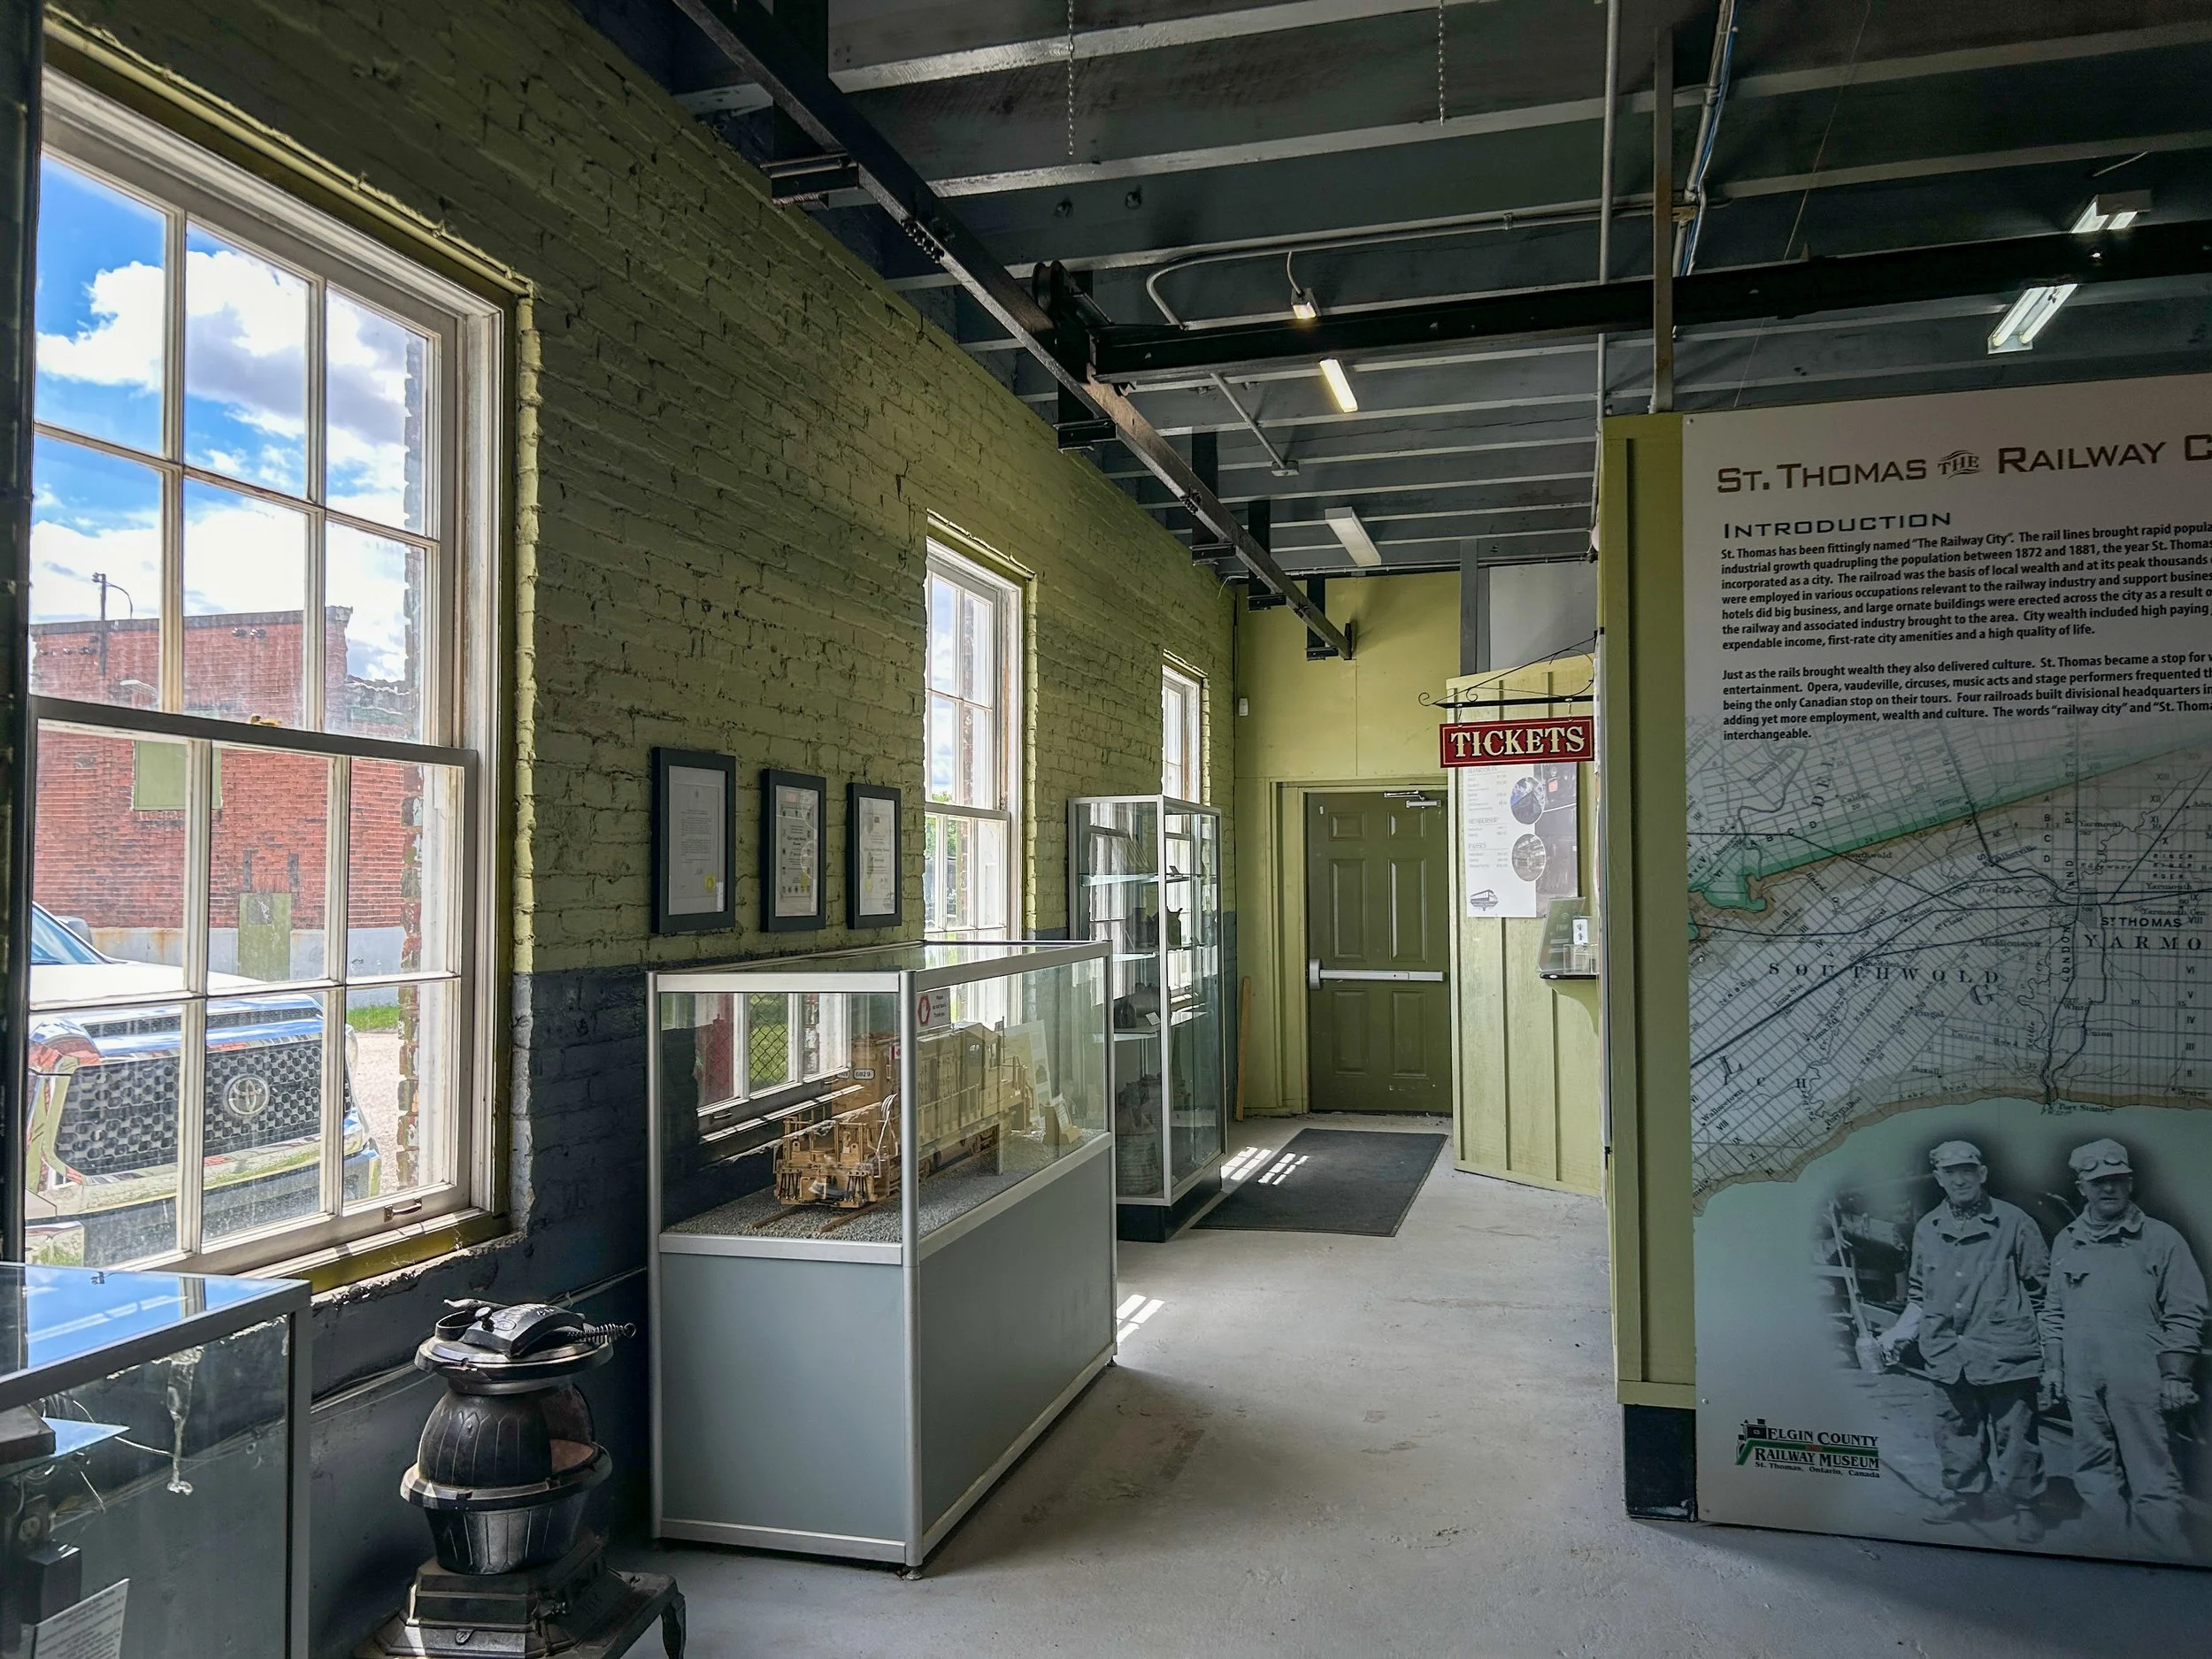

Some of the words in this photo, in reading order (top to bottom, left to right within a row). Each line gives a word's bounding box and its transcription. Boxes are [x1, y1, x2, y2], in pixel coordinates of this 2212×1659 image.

[1721, 549, 1735, 560] St.
[1736, 548, 1778, 558] Thomas
[1778, 546, 1797, 557] has
[1799, 544, 1825, 556] been
[1826, 541, 1871, 555] fittingly
[1872, 538, 1910, 551] named
[1939, 535, 1984, 548] Railway
[2017, 531, 2040, 543] The
[2041, 529, 2061, 541] rail
[2062, 528, 2091, 541] lines
[2092, 525, 2139, 540] brought
[2141, 523, 2172, 538] rapid
[1721, 561, 1771, 575] industrial
[1772, 559, 1811, 574] growth
[1813, 557, 1878, 572] quadrupling
[1879, 555, 1899, 566] the
[1901, 551, 1962, 568] population
[1962, 550, 2013, 562] between
[2015, 547, 2043, 559] 1872
[2044, 544, 2067, 557] and
[2069, 543, 2101, 557] 1881,
[2101, 542, 2123, 554] the
[2124, 543, 2150, 556] year
[2151, 540, 2169, 551] St.
[1721, 595, 1747, 604] were
[1748, 590, 1801, 605] employed
[1801, 590, 1813, 601] in
[1814, 588, 1854, 600] various
[1855, 585, 1919, 600] occupations
[1921, 583, 1967, 595] relevant
[1969, 582, 1981, 593] to
[1983, 580, 2003, 592] the
[2004, 579, 2047, 592] railway
[2048, 576, 2097, 589] industry
[2098, 573, 2121, 587] and
[2122, 572, 2168, 587] support
[1722, 608, 1755, 620] hotels
[1755, 606, 1772, 618] did
[1774, 606, 1792, 619] big
[1793, 604, 1841, 617] business,
[1843, 603, 1864, 614] and
[1865, 602, 1893, 615] large
[1895, 601, 1932, 611] ornate
[1933, 597, 1986, 611] buildings
[1987, 597, 2016, 608] were
[2017, 593, 2061, 606] erected
[2062, 594, 2098, 603] across
[2100, 590, 2120, 603] the
[2121, 589, 2143, 603] city
[2144, 590, 2158, 600] as
[2159, 590, 2167, 599] a
[2169, 586, 2203, 599] result
[1722, 637, 1783, 652] expendable
[1784, 636, 1826, 648] income,
[1827, 634, 1876, 646] first-rate
[1877, 633, 1898, 646] city
[1899, 630, 1954, 642] amenities
[1955, 628, 1977, 641] and
[1978, 630, 1986, 639] a
[1988, 626, 2014, 641] high
[2016, 625, 2057, 640] quality
[2058, 624, 2071, 635] of
[2072, 623, 2095, 635] life.
[1722, 670, 1744, 680] Just
[1744, 671, 1757, 680] as
[1758, 668, 1777, 679] the
[1778, 666, 1801, 679] rails
[1802, 665, 1846, 679] brought
[1847, 664, 1885, 675] wealth
[1886, 663, 1912, 676] they
[1913, 662, 1936, 673] also
[1937, 659, 1990, 672] delivered
[1991, 658, 2036, 671] culture.
[2039, 657, 2056, 668] St.
[2057, 656, 2102, 668] Thomas
[2104, 654, 2149, 666] became
[2151, 656, 2159, 664] a
[2161, 653, 2186, 665] stop
[2187, 650, 2207, 663] for
[1723, 683, 1803, 695] entertainment.
[1807, 681, 1842, 695] Opera,
[1843, 679, 1903, 691] vaudeville,
[1904, 678, 1950, 689] circuses,
[1952, 675, 1985, 687] music
[1986, 675, 2009, 687] acts
[2011, 673, 2033, 685] and
[2035, 674, 2067, 687] stage
[2069, 671, 2133, 686] performers
[2135, 667, 2201, 683] frequented
[1723, 714, 1760, 727] adding
[1761, 714, 1778, 727] yet
[1779, 715, 1808, 724] more
[1809, 710, 1880, 725] employment,
[1882, 709, 1920, 721] wealth
[1922, 708, 1943, 719] and
[1945, 707, 1988, 718] culture.
[1992, 706, 2014, 718] The
[2016, 704, 2050, 717] words
[2129, 701, 2152, 713] and
[1450, 726, 1586, 757] TICKETS
[1723, 727, 1812, 742] interchangeable.
[2119, 917, 2183, 928] THOMAS
[1848, 1470, 1880, 1479] Canada
